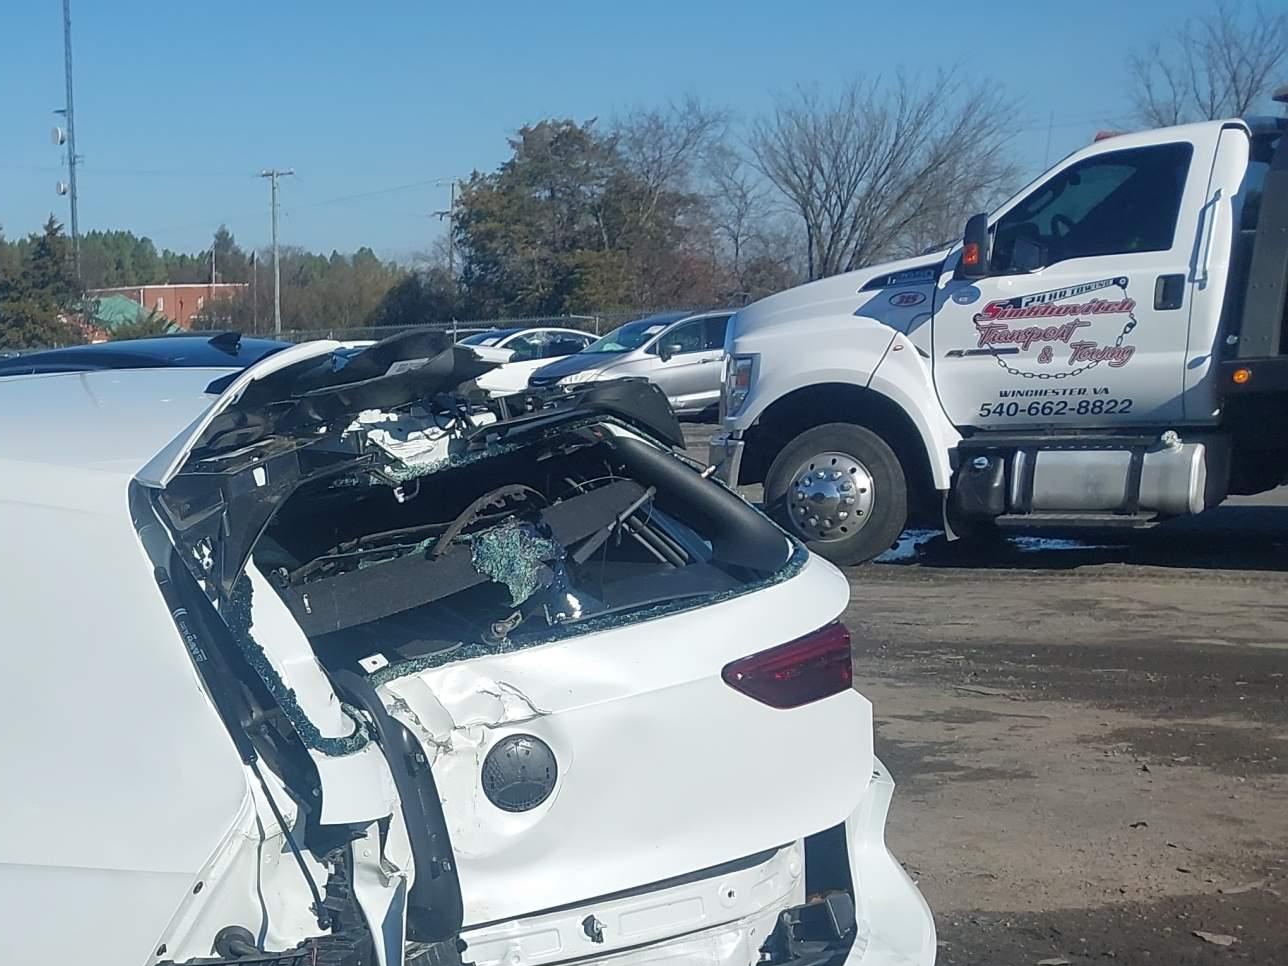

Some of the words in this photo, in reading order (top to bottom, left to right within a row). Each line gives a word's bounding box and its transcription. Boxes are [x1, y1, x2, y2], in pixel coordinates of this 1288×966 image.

[1047, 289, 1066, 301] HR
[1071, 280, 1111, 295] TOWING
[1038, 345, 1054, 364] &
[1068, 340, 1136, 368] Towing
[1092, 387, 1110, 395] VA
[979, 398, 1133, 418] 540-662-8822
